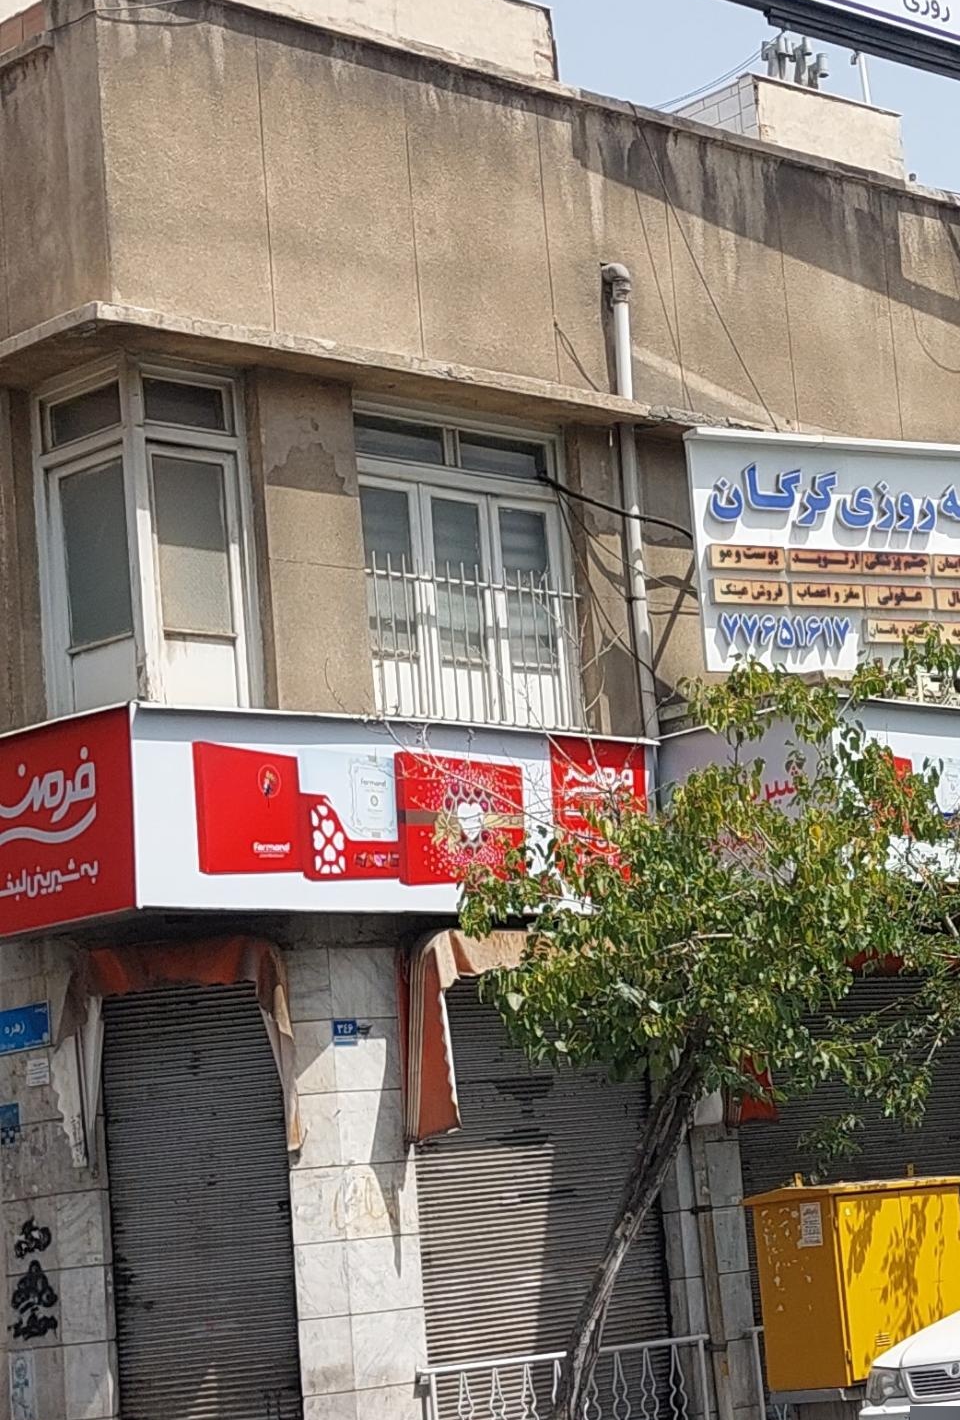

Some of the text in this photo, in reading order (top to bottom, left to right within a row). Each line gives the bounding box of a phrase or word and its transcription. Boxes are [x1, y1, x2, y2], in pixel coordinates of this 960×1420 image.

[711, 462, 837, 527] گرگان
[840, 481, 937, 532] روزی
[718, 547, 779, 566] پوست و مو
[719, 582, 783, 602] فروش عینک
[796, 584, 860, 603] مغز و اعصاب
[877, 588, 923, 607] عفونی
[720, 612, 851, 648] ۷۷۶۵۱۶۱۷
[0, 746, 96, 823] فرمن
